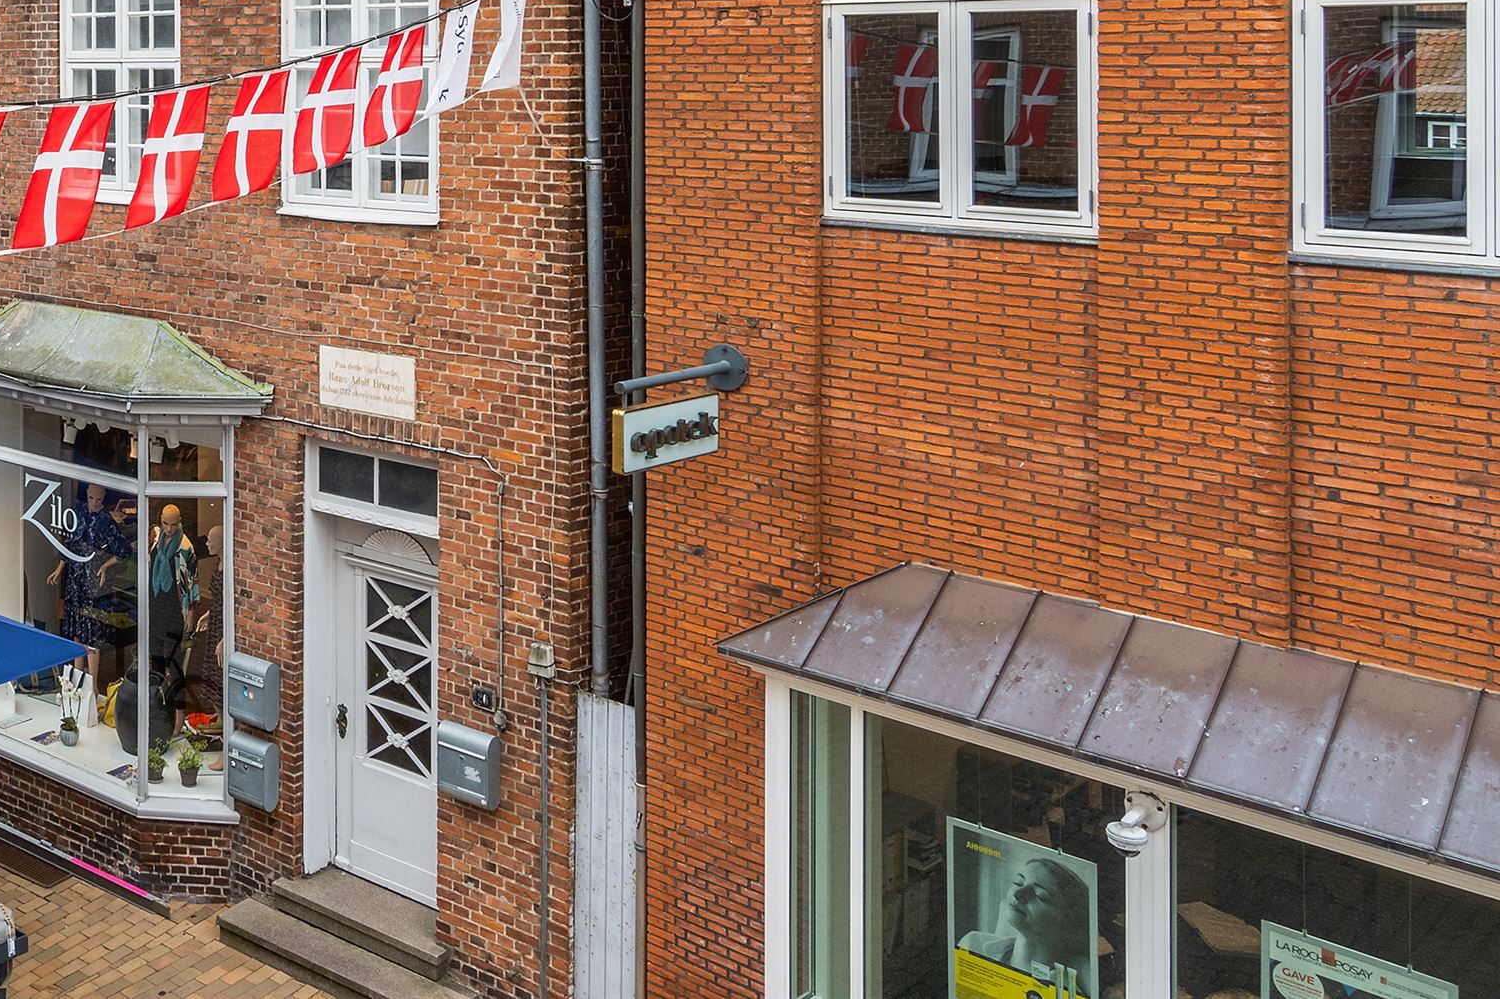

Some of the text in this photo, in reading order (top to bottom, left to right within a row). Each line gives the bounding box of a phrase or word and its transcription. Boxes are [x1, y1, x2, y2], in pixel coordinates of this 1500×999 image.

[328, 371, 348, 383] Hans
[351, 375, 370, 387] Adolf
[631, 411, 720, 460] apotek
[20, 472, 96, 562] Zilo
[1276, 939, 1291, 952] LA
[1282, 967, 1315, 985] GAVE
